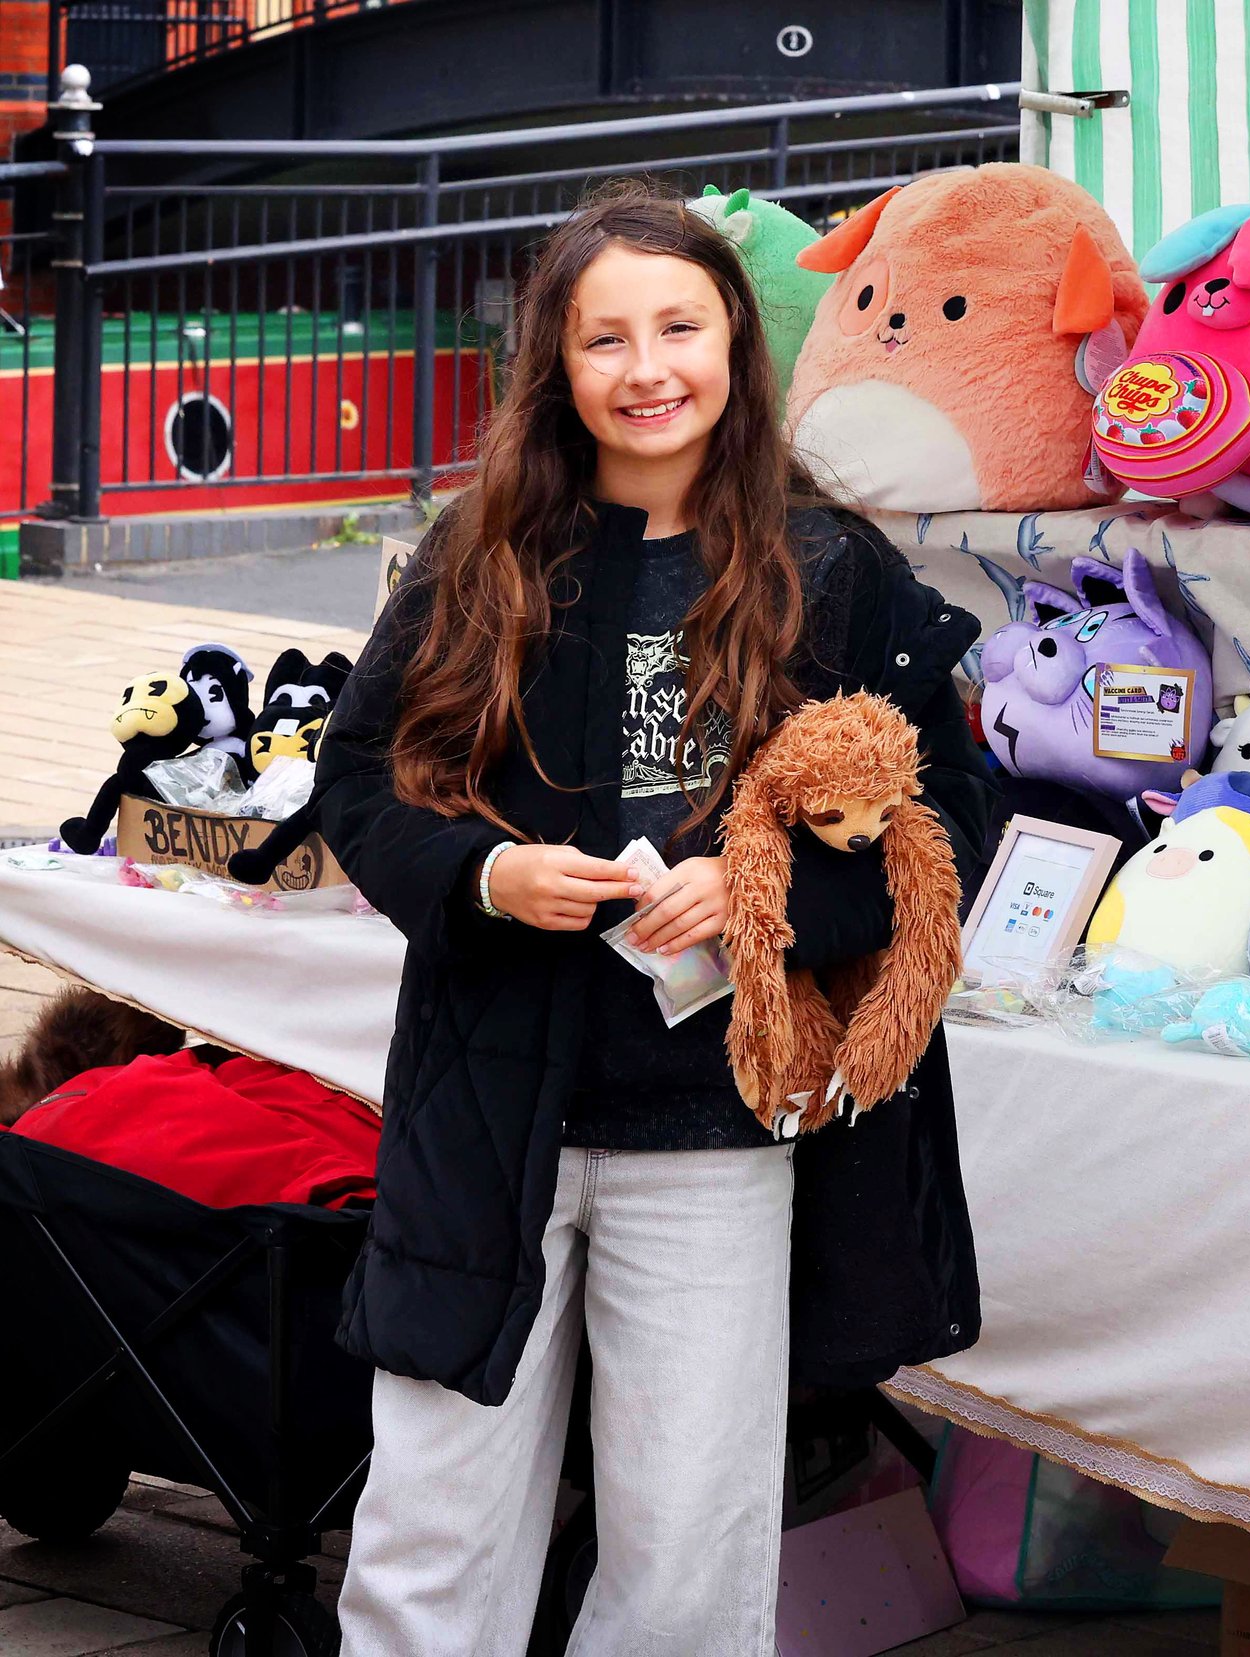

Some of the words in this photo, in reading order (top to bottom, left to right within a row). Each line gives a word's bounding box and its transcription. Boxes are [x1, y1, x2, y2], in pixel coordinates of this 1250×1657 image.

[1118, 370, 1172, 394] Chupa
[1108, 383, 1162, 409] Chups
[626, 684, 688, 724] nse
[143, 808, 250, 866] BENDY
[1032, 885, 1055, 899] Square
